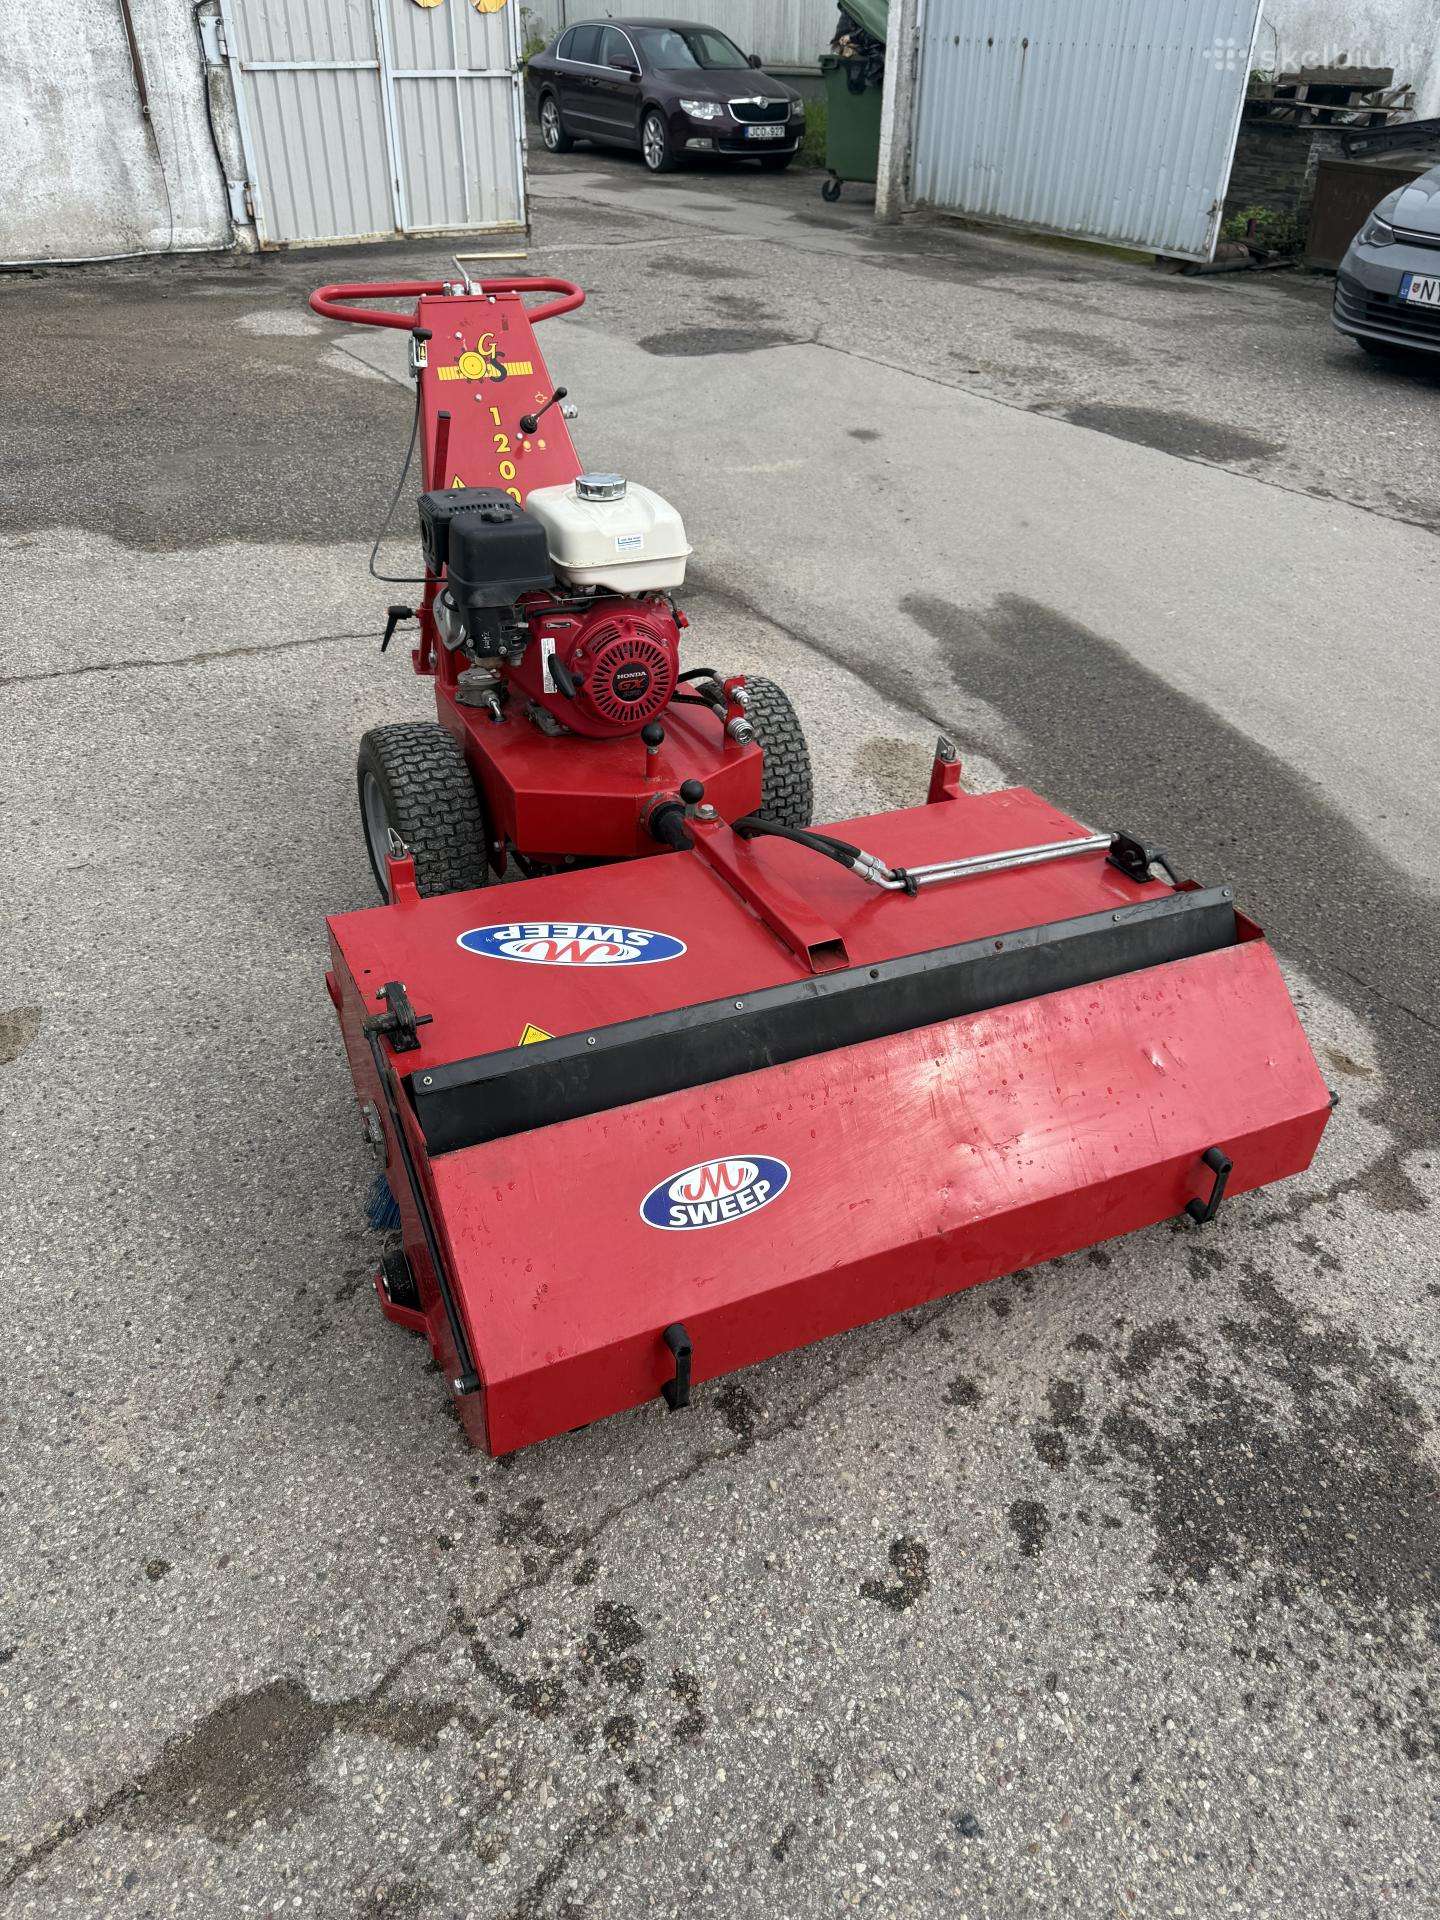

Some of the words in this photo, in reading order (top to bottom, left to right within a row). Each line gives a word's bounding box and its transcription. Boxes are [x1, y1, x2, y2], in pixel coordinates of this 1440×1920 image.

[1420, 279, 1440, 303] N
[616, 671, 647, 680] HONDA
[617, 677, 646, 691] GX
[493, 924, 654, 946] SWEEP
[669, 1179, 771, 1226] SWEEP
